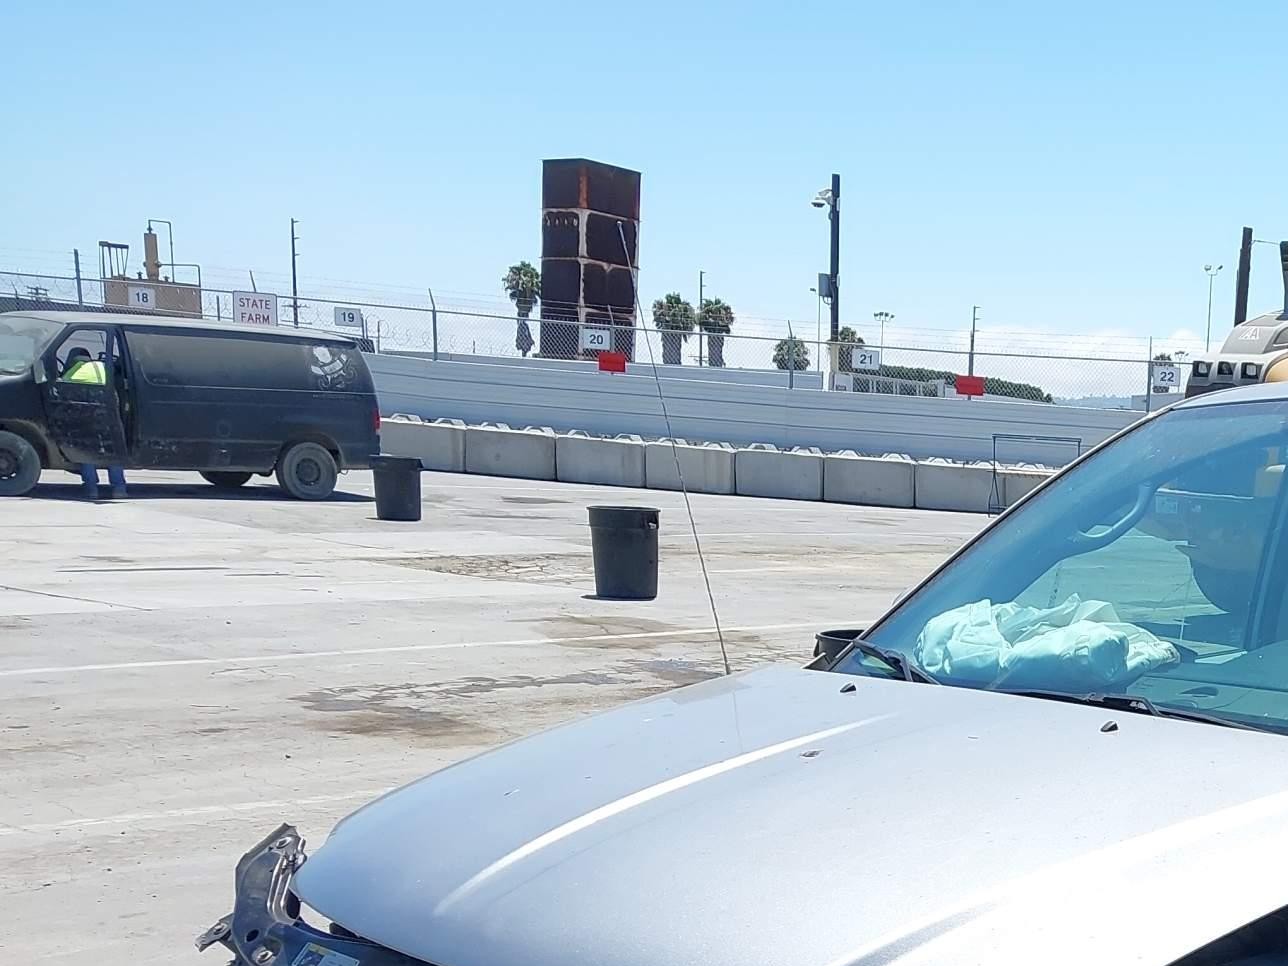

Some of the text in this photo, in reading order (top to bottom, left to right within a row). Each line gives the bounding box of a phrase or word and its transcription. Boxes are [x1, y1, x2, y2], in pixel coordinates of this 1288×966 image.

[135, 292, 149, 303] 18
[239, 297, 271, 310] STATE
[240, 312, 270, 325] FARM
[340, 311, 355, 323] 19
[589, 334, 604, 345] 20
[859, 353, 873, 365] 21
[1159, 371, 1175, 383] 22
